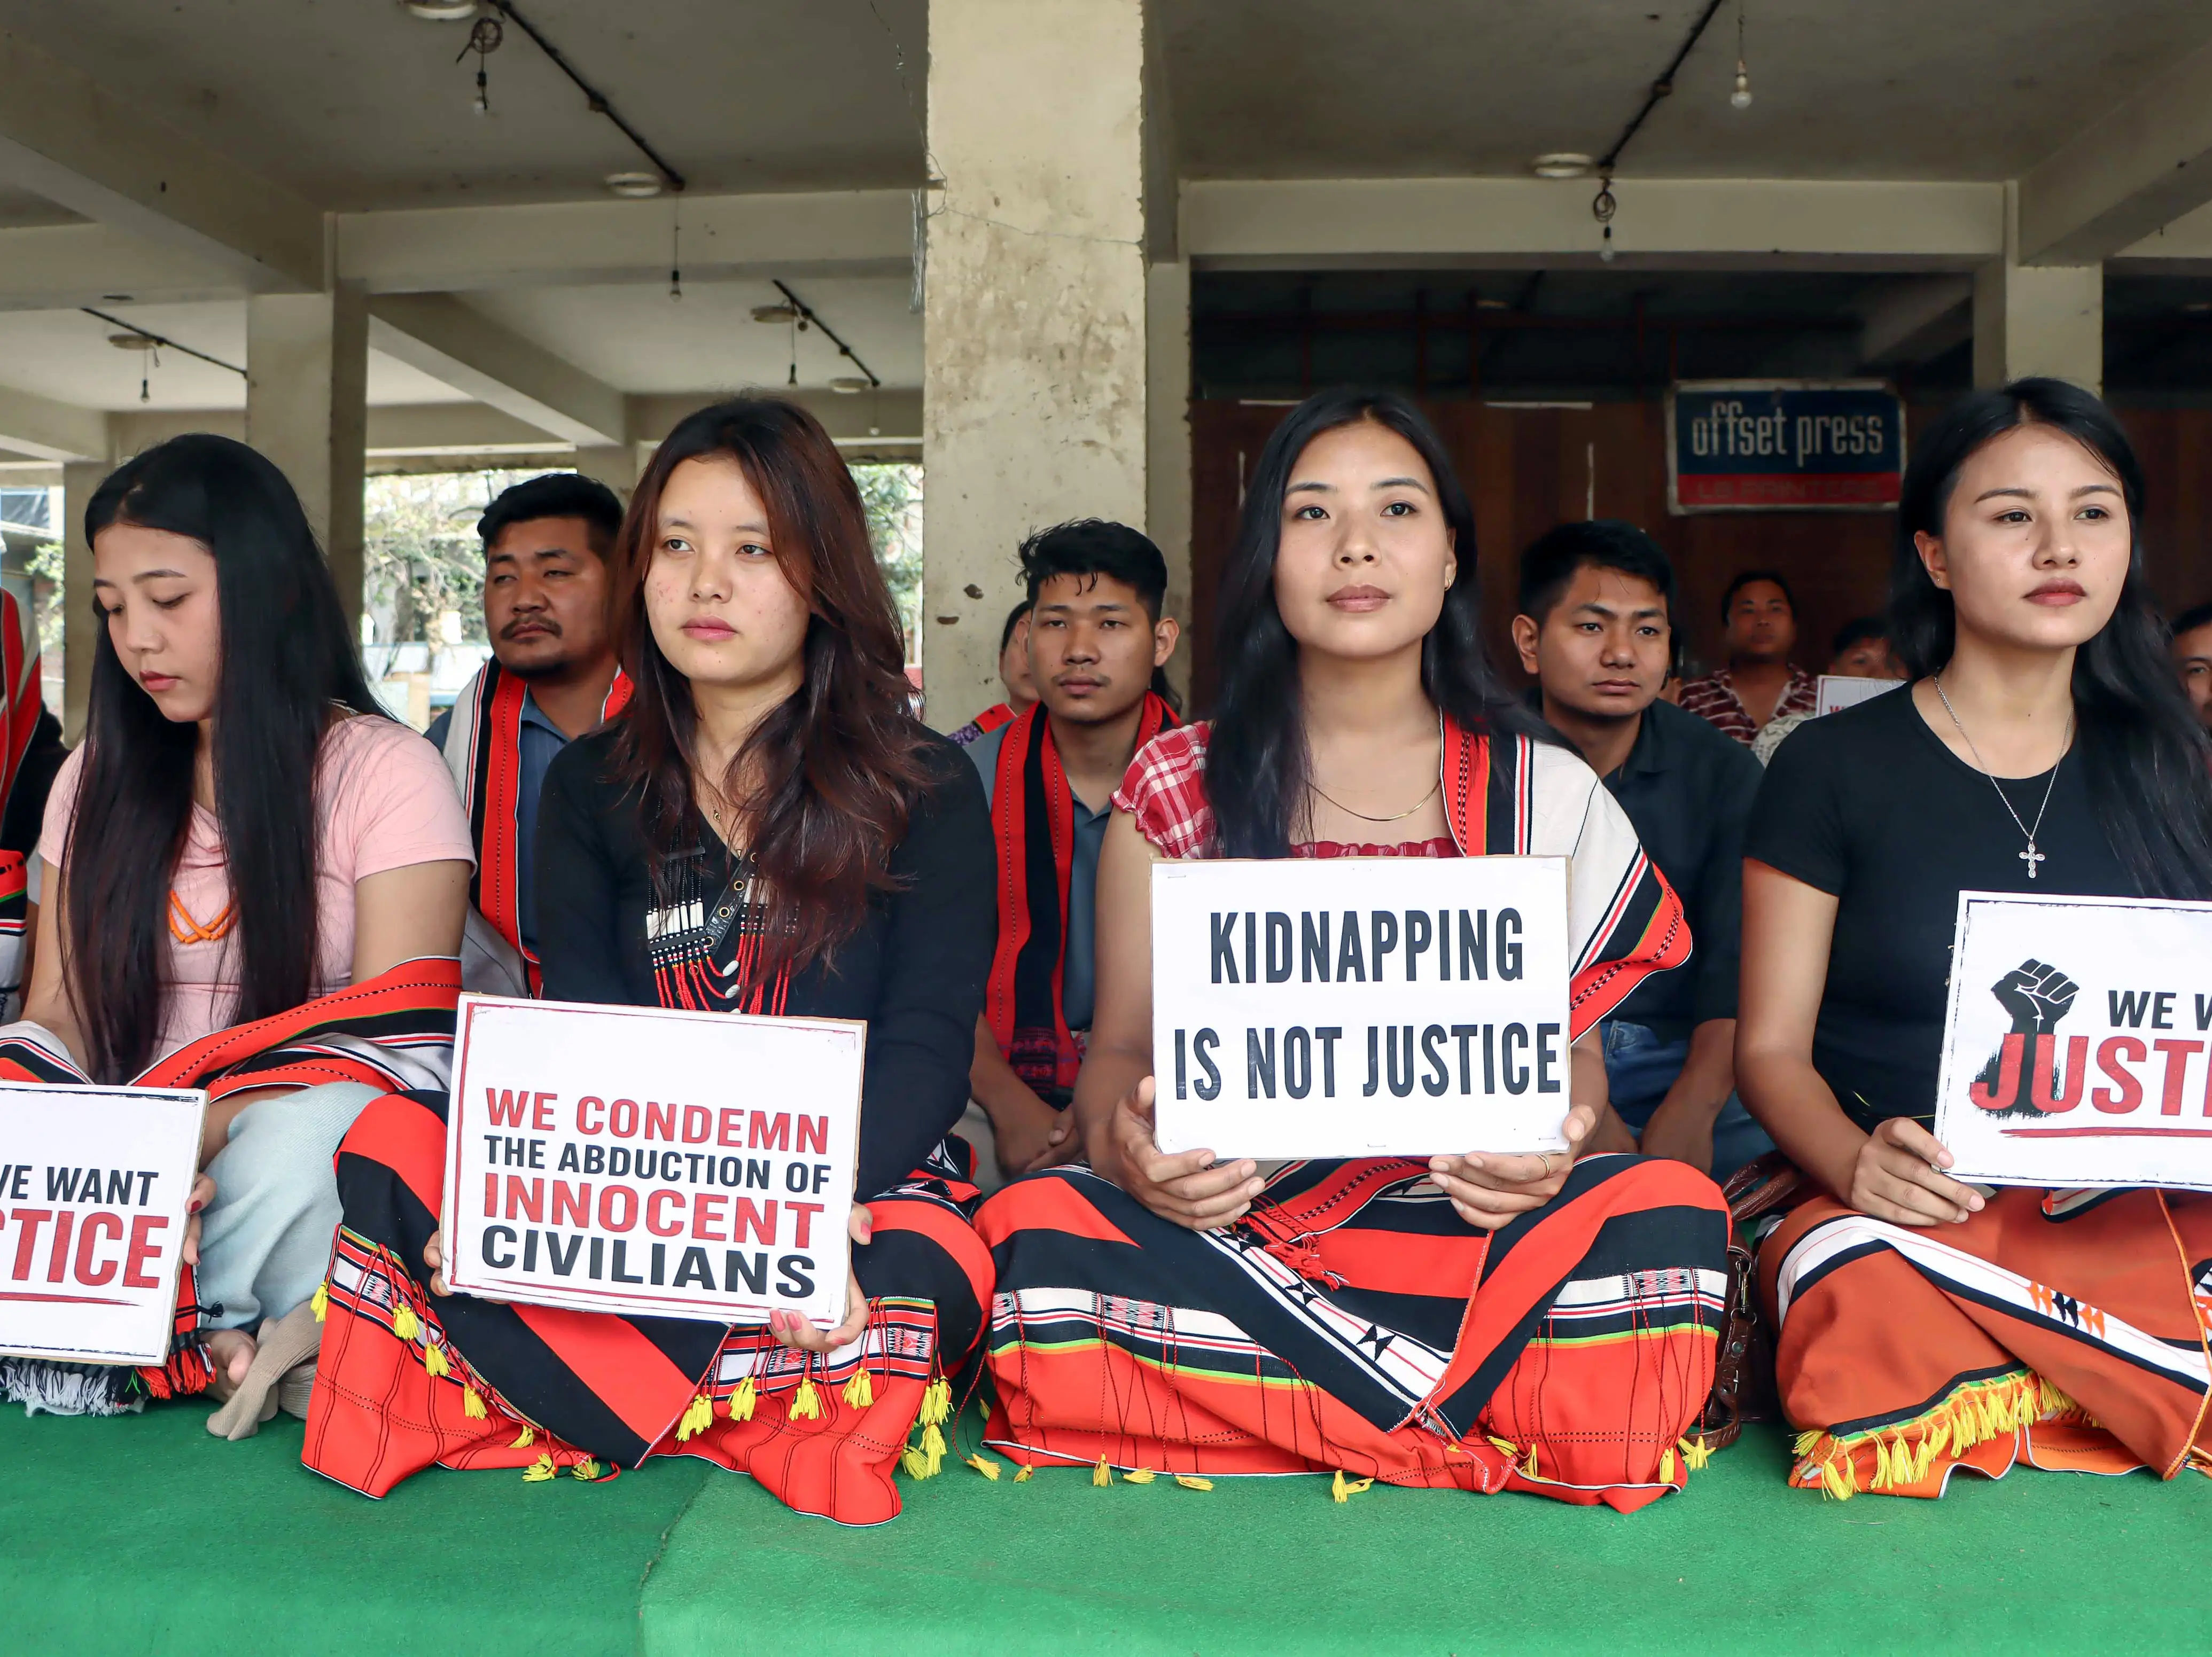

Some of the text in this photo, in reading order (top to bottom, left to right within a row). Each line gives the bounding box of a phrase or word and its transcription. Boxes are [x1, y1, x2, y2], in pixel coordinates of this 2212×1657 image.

[1692, 401, 1883, 468] offset press
[1210, 908, 1523, 984] KIDNAPPING
[2108, 990, 2177, 1029] WE
[1174, 1022, 1561, 1101] IS NOT JUSTICE
[486, 1088, 829, 1154] WE CONDEMN
[47, 1166, 159, 1206] WANT
[484, 1135, 831, 1194] THE ABDUCTION OF
[484, 1173, 824, 1249] INNOCENT
[0, 1208, 169, 1289] TICE
[482, 1225, 815, 1299] CIVILIANS
